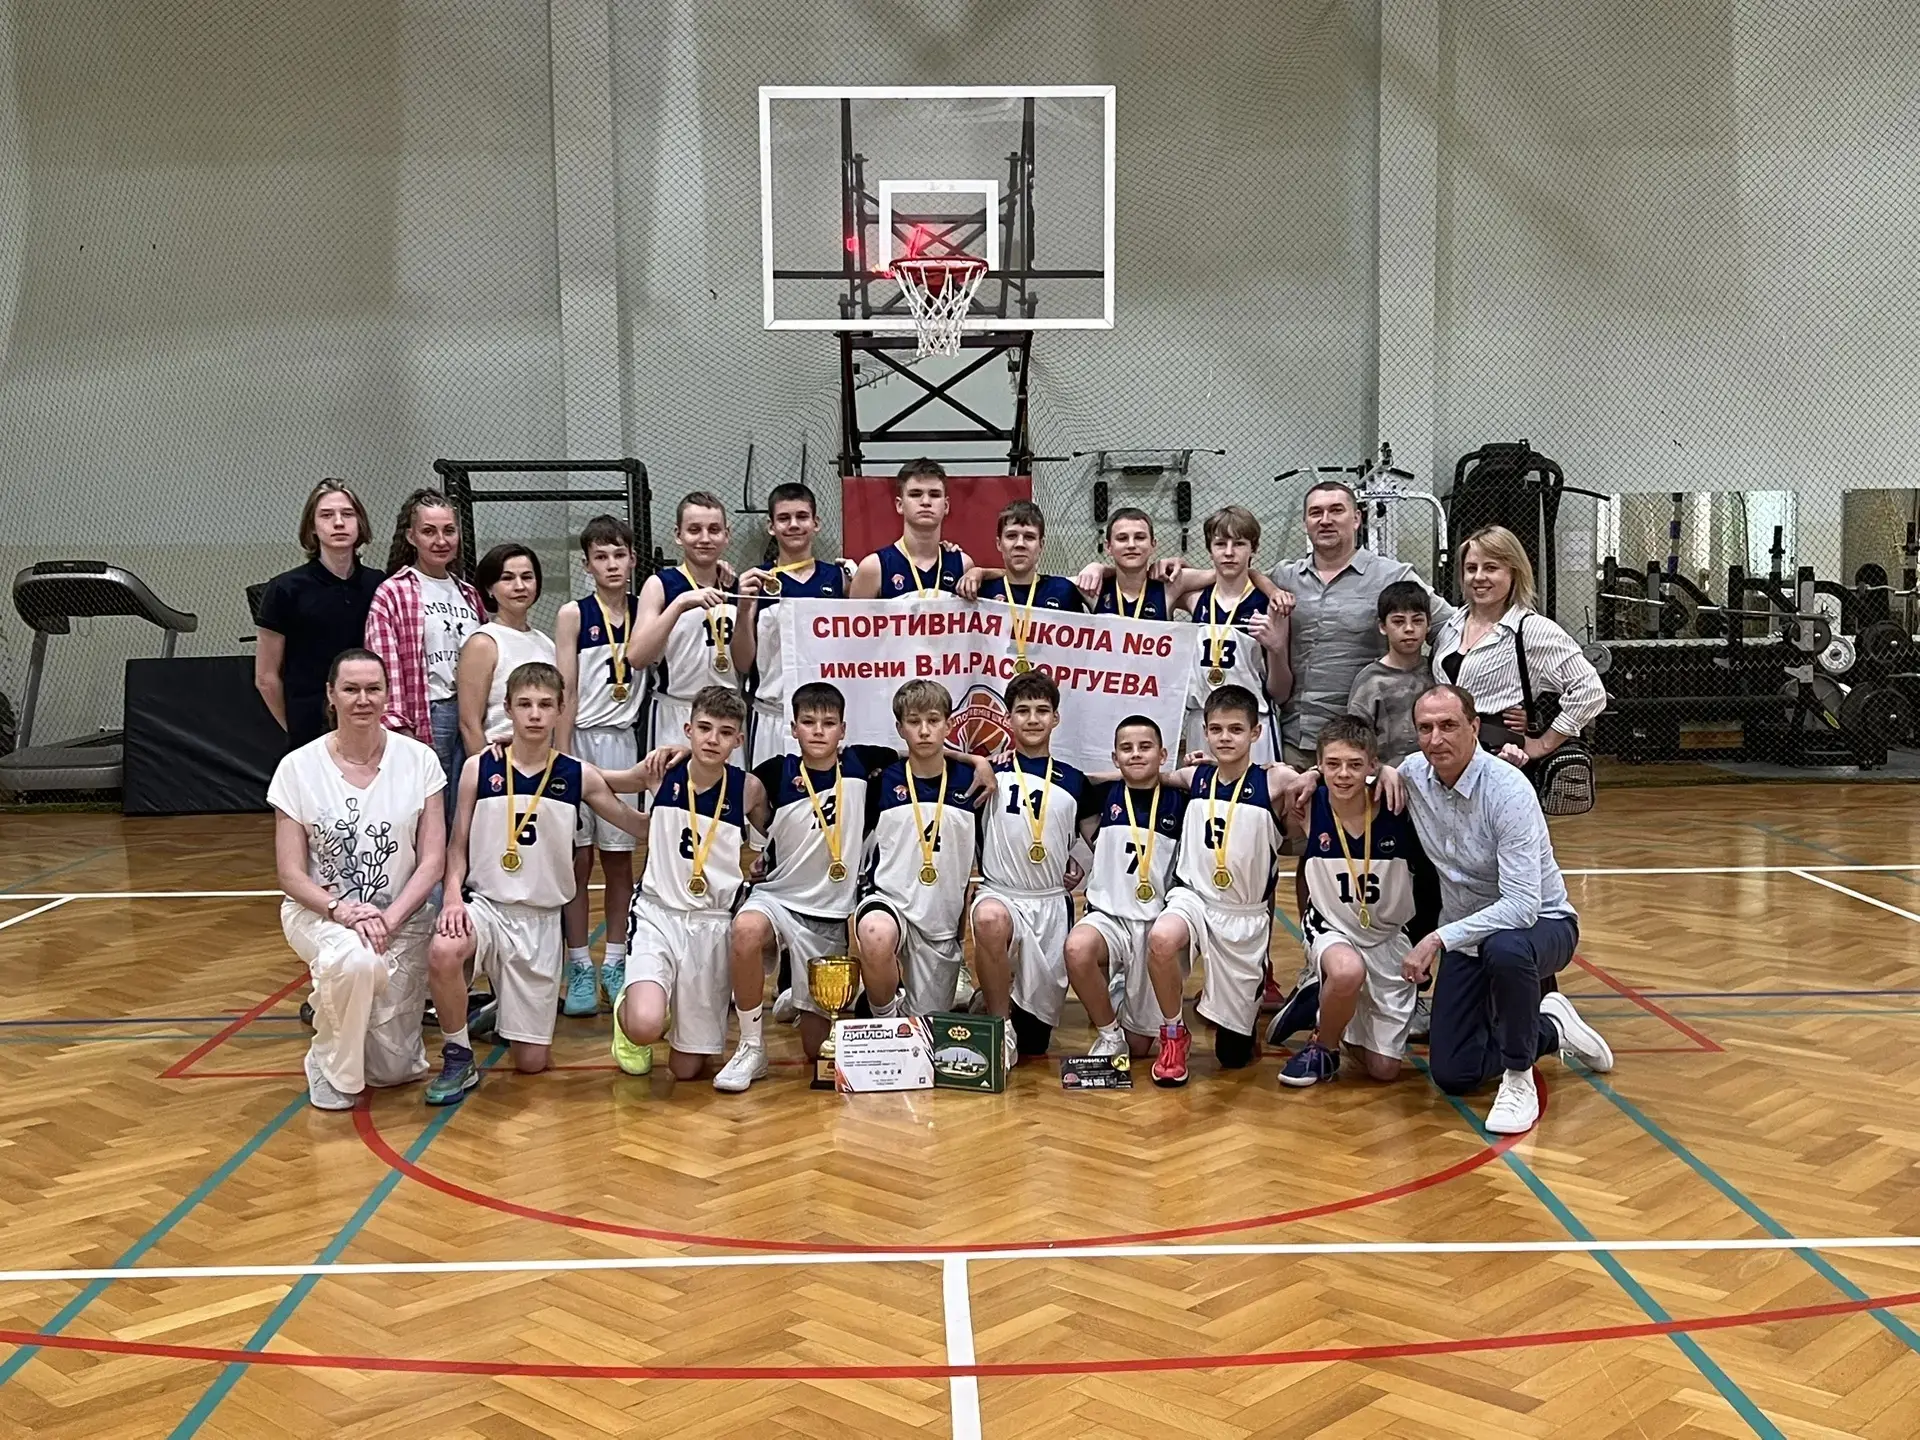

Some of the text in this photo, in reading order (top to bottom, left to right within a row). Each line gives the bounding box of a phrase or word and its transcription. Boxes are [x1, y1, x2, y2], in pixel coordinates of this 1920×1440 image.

[812, 611, 1173, 657] СПОРТИВНАЯ ШКОЛА №6
[1200, 638, 1237, 670] 13
[820, 652, 1159, 697] имени В.И.РАСОРГУЕВА
[1006, 784, 1045, 820] 14
[515, 812, 538, 846] 5
[679, 827, 702, 860] 8
[1204, 817, 1227, 850] 6
[1125, 842, 1146, 875] 7
[1336, 872, 1380, 904] 16
[843, 1029, 893, 1041] ДИПЛОМ
